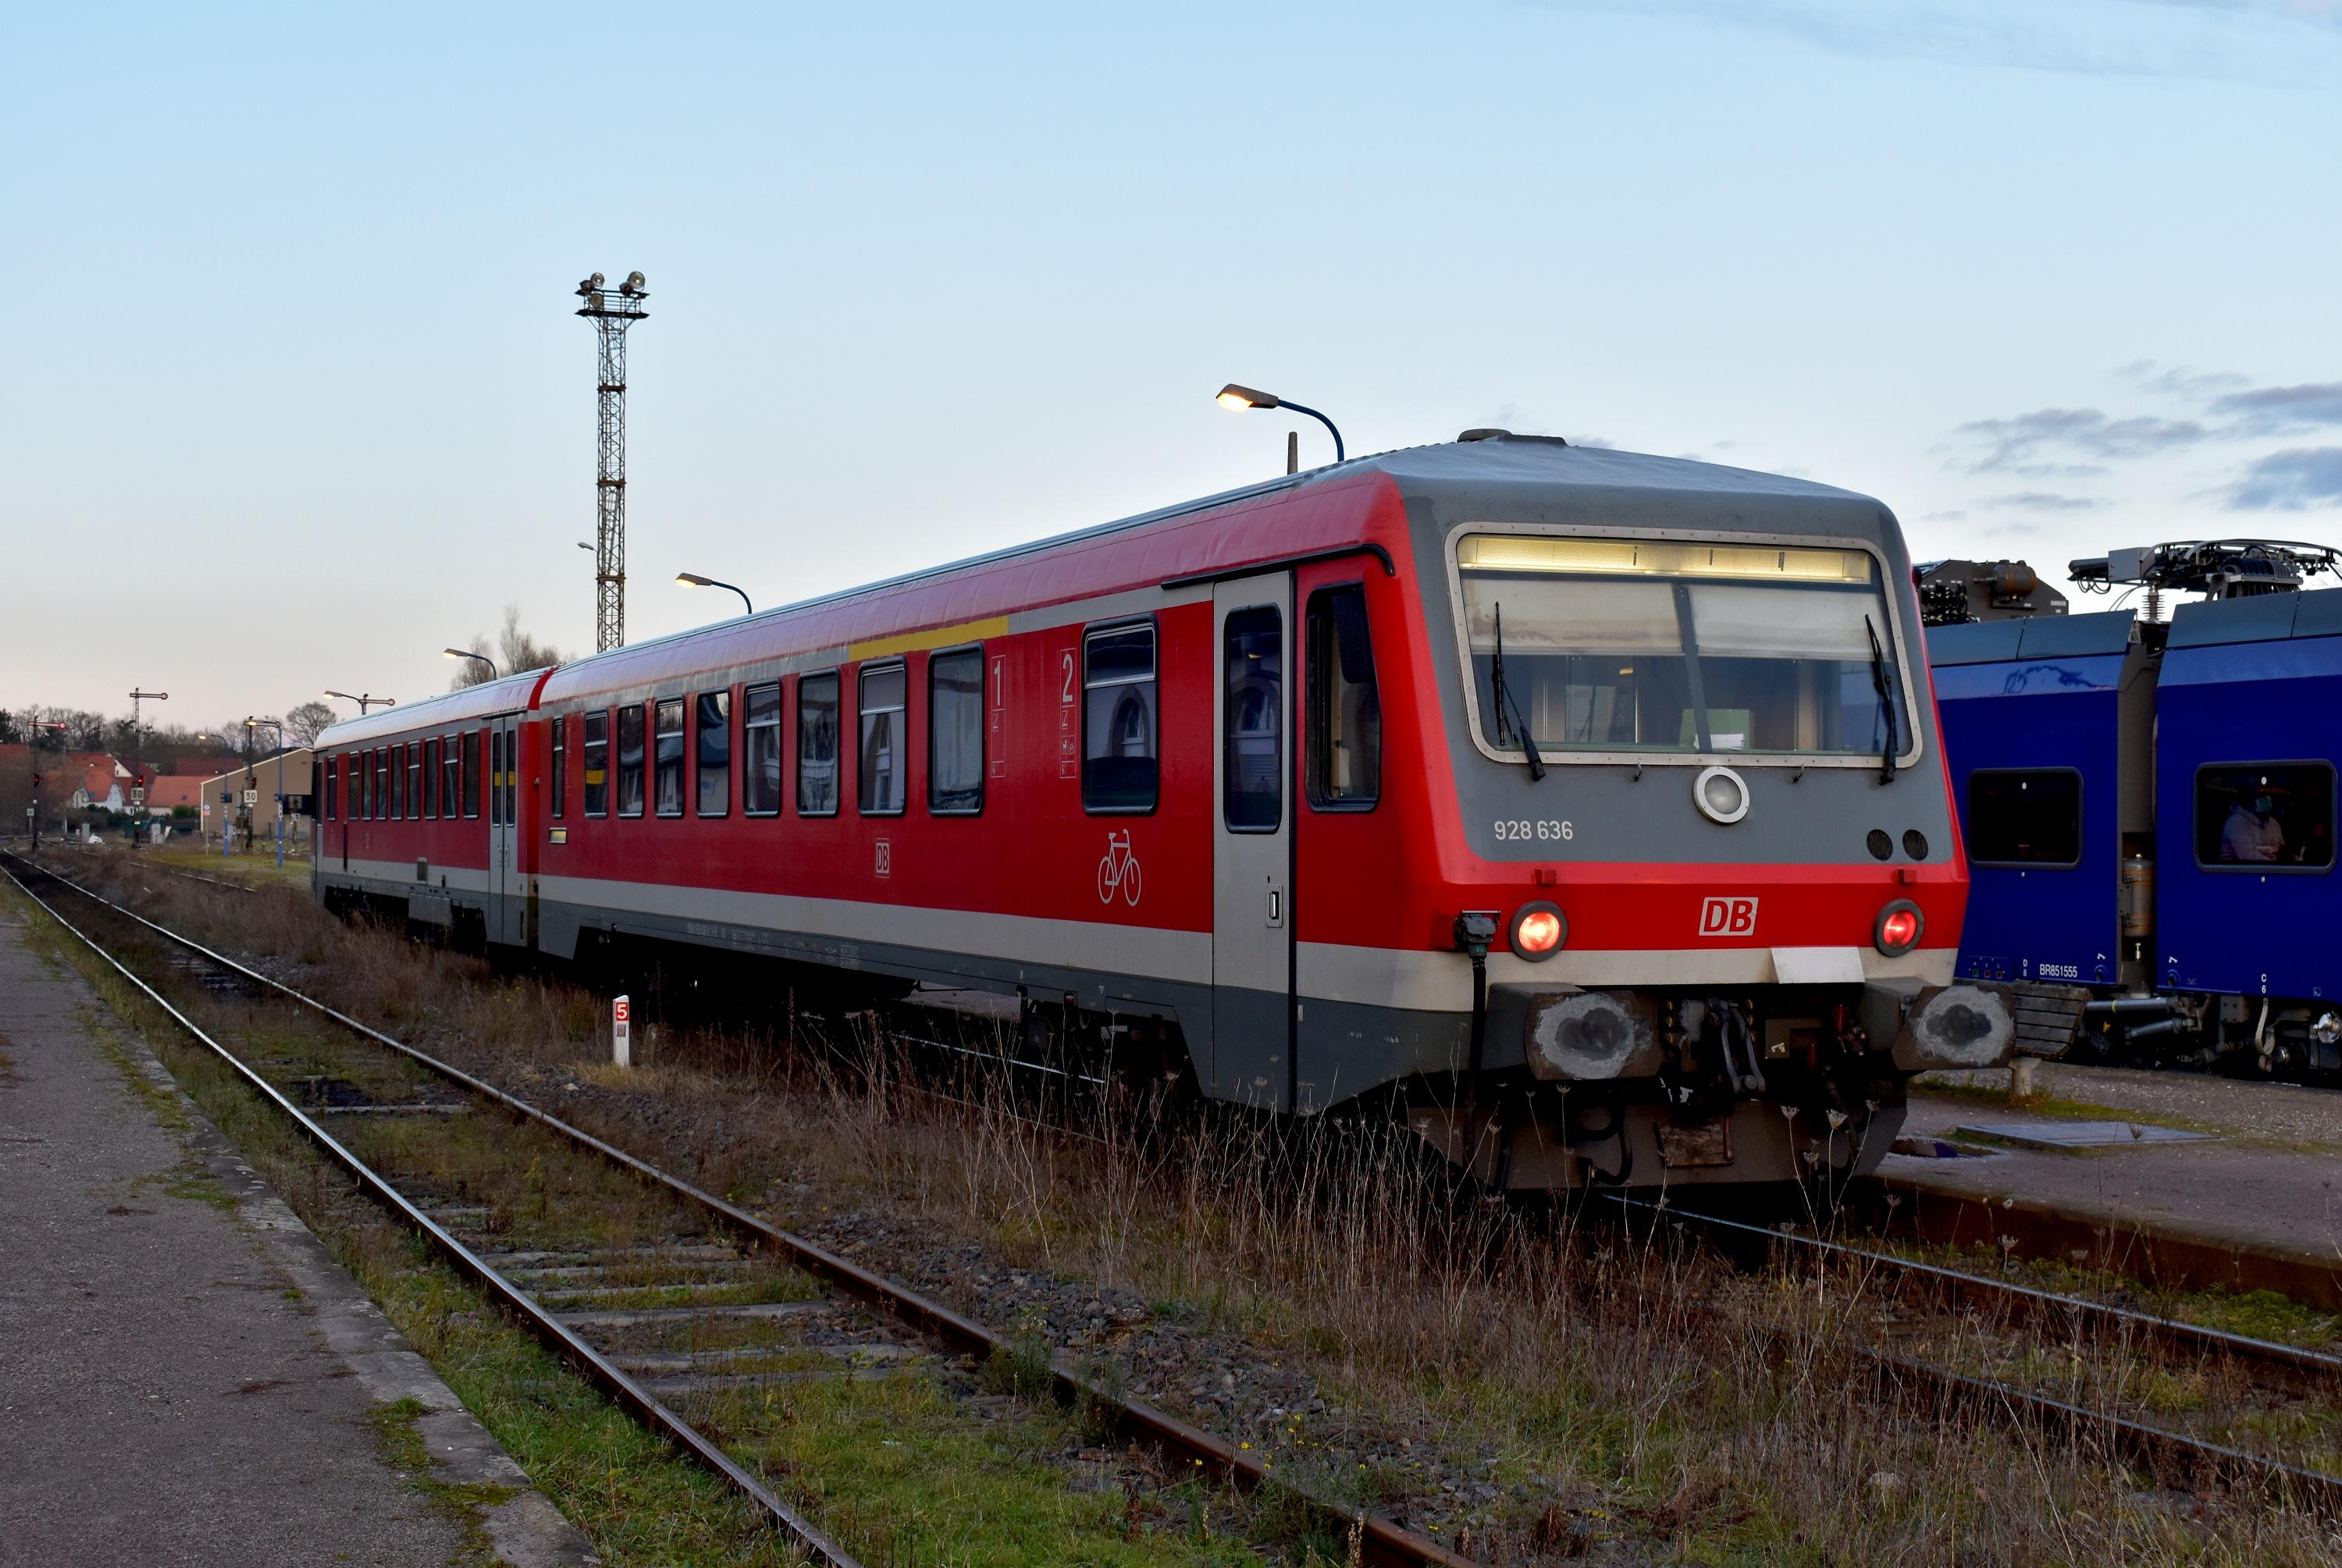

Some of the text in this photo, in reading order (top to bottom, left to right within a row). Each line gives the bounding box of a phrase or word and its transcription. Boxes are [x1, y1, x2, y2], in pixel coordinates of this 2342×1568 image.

[994, 660, 1001, 706] 1
[1062, 653, 1073, 702] 2
[132, 790, 143, 798] 30
[245, 792, 256, 801] 30
[1494, 820, 1573, 840] 928 636
[877, 844, 888, 871] DB
[1703, 899, 1753, 933] DB
[2039, 963, 2078, 978] BR851555
[2261, 973, 2267, 983] C
[617, 1004, 628, 1019] 5
